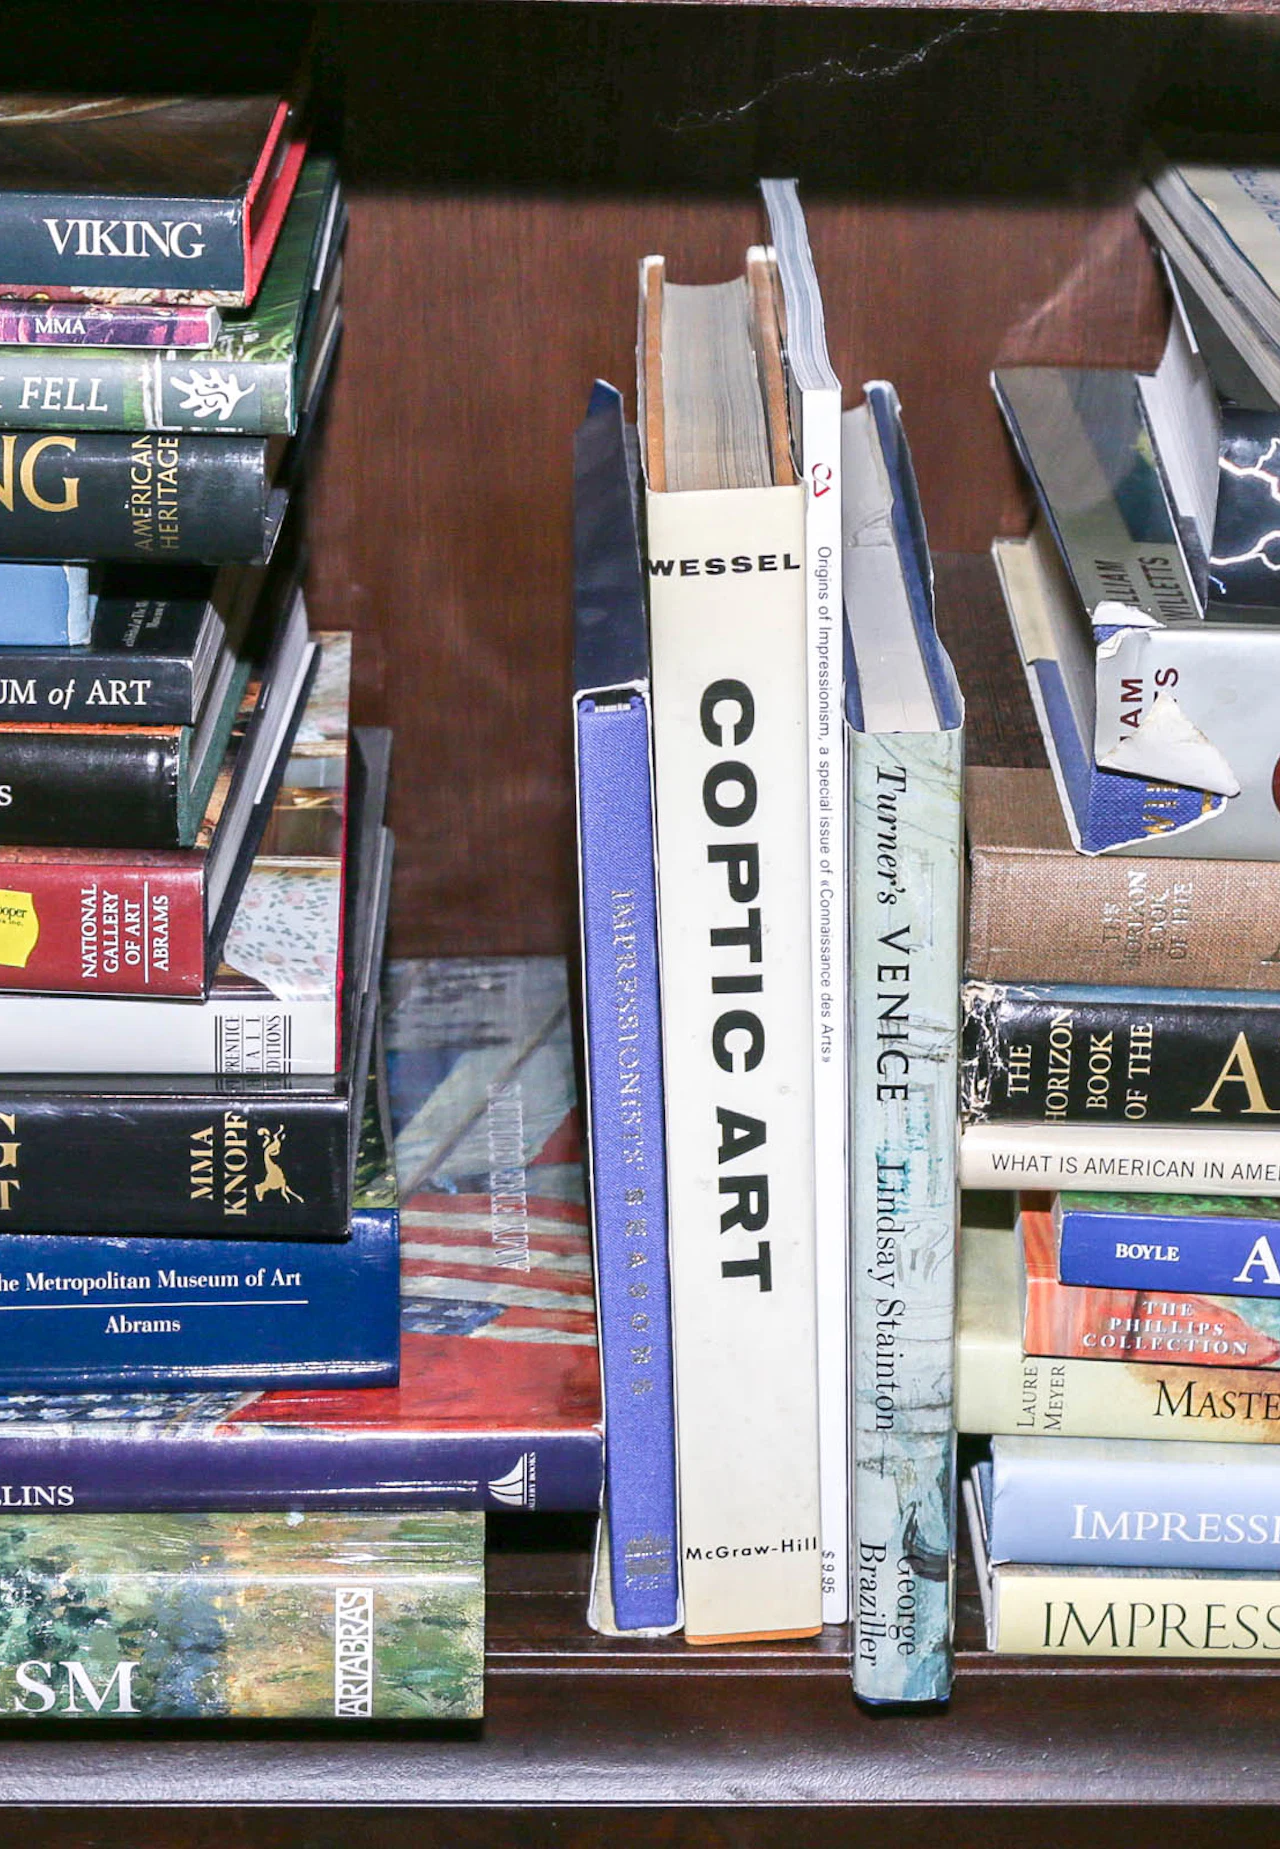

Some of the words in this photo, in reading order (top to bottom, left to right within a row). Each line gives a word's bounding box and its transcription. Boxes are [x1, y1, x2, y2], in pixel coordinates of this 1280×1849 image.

[43, 218, 206, 260] VIKING
[35, 317, 85, 336] MMA
[19, 376, 109, 413] FELL
[648, 553, 801, 577] WESSEL
[815, 546, 832, 600] Origins
[818, 605, 832, 620] of
[815, 627, 832, 740] Impressionism,
[819, 747, 830, 755] a
[816, 761, 833, 811] special
[819, 816, 833, 854] issue
[874, 765, 907, 905] Turner's
[699, 678, 765, 1074] COPTIC
[819, 859, 834, 874] of
[81, 883, 98, 979] NATIONAL
[103, 890, 119, 974] GALLERY
[125, 899, 141, 940] ART
[152, 894, 169, 972] ABRAMS
[125, 944, 141, 966] OF
[820, 992, 833, 1018] des
[875, 924, 910, 1103] VENICE
[190, 1125, 215, 1201] MMA
[223, 1110, 248, 1216] KNOPF
[991, 1153, 1053, 1174] WHAT
[1058, 1156, 1079, 1174] IS
[1083, 1157, 1195, 1178] AMERICAN
[1204, 1161, 1225, 1179] IN
[715, 1106, 772, 1294] ART
[871, 1163, 907, 1290] Lindsay
[1115, 1242, 1180, 1263] BOYLE
[25, 1270, 152, 1297] Metropolitan
[157, 1271, 240, 1290] Museum
[245, 1269, 267, 1290] of
[271, 1269, 302, 1290] Art
[104, 1315, 181, 1336] Abrams
[1108, 1315, 1226, 1338] PHILLIPS
[1141, 1300, 1195, 1319] THE
[1082, 1333, 1250, 1357] COLLECTION
[875, 1301, 906, 1432] Stainton
[1016, 1366, 1039, 1428] LAURE
[1043, 1365, 1066, 1431] MEYER
[686, 1536, 818, 1561] McGraw-Hill
[859, 1542, 887, 1666] Braziller
[894, 1555, 915, 1656] George
